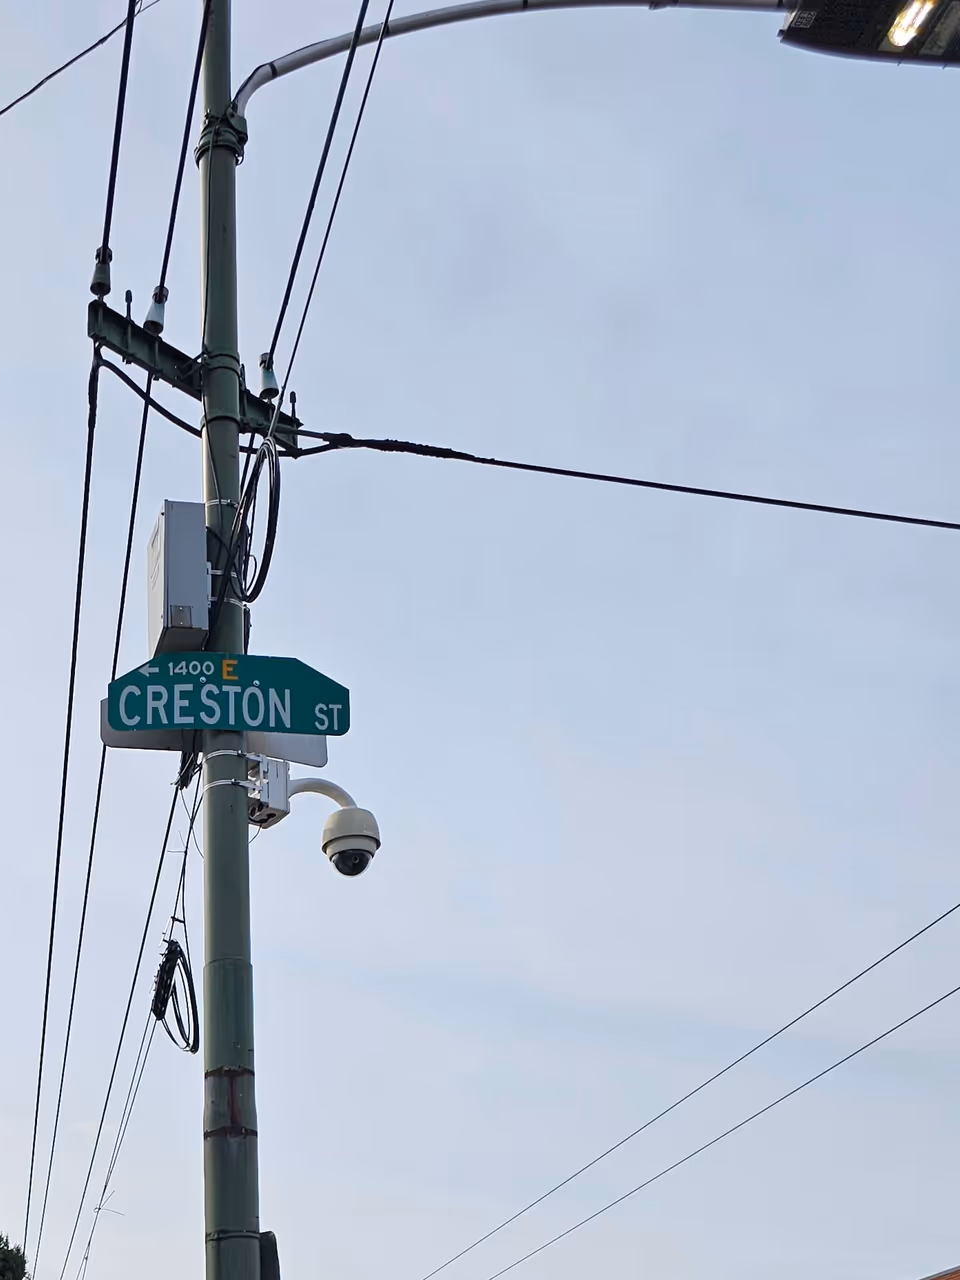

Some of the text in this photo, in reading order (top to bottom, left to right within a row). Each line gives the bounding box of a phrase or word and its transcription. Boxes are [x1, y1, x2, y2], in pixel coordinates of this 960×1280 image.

[168, 659, 239, 681] 1400 E
[119, 683, 342, 731] CRESTON ST
